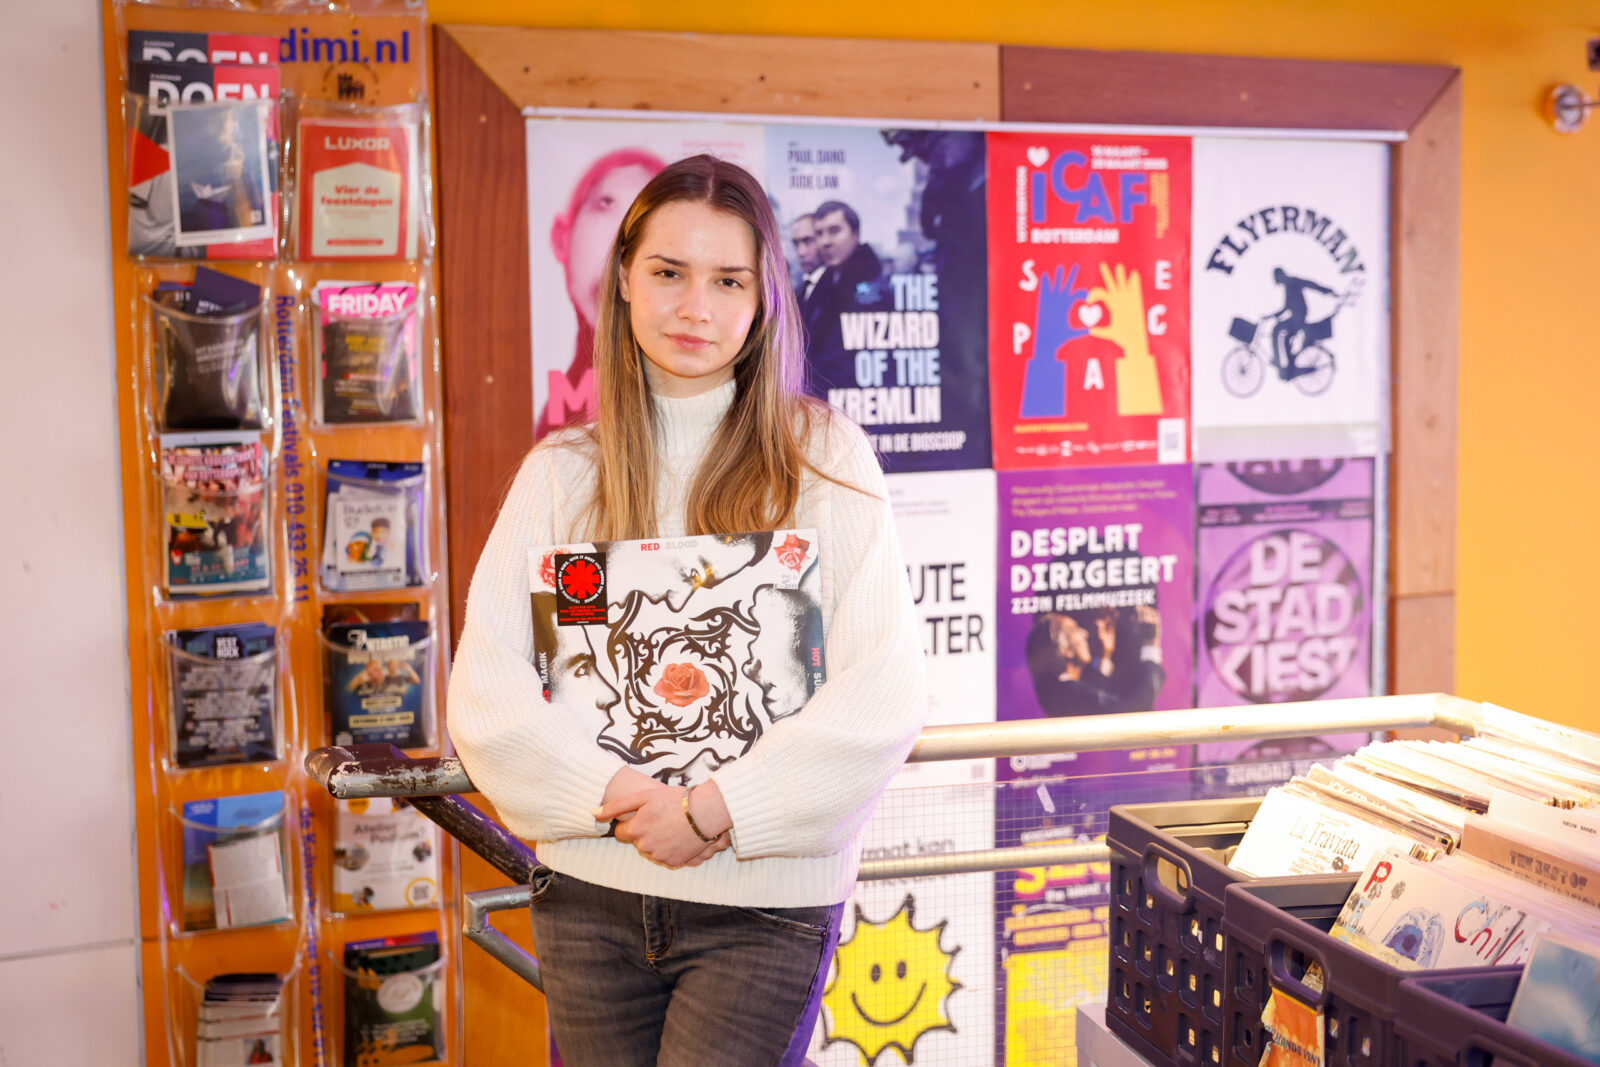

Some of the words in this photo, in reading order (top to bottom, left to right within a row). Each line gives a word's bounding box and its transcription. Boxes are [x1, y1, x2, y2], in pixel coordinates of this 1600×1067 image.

[325, 136, 390, 150] LUXOR
[321, 196, 394, 208] feestdagen
[334, 184, 360, 195] Vier
[364, 186, 380, 195] de
[1030, 228, 1120, 244] ROTTERDAM
[1206, 206, 1366, 275] FLYERMAN
[327, 292, 408, 315] FRIDAY
[890, 273, 940, 312] THE
[276, 295, 298, 393] Rotterdam
[839, 311, 940, 351] WIZARD
[854, 350, 888, 387] OF
[892, 348, 942, 387] THE
[828, 385, 942, 426] KREMLIN
[281, 398, 304, 478] Festivals
[910, 430, 967, 452] BIOSCOOP
[641, 543, 660, 551] RED
[665, 540, 698, 550] BLOOD
[1010, 523, 1143, 558] DESPLAT
[1250, 532, 1323, 586] DE
[1010, 554, 1179, 593] DIRIGEERT
[1011, 595, 1053, 615] ZIJN
[1056, 588, 1157, 612] FILMMUZIEK
[1212, 584, 1353, 645] STAD
[924, 614, 985, 656] TER
[539, 651, 549, 684] MAGIK
[812, 647, 821, 667] HOT
[1210, 636, 1359, 695] KIEST
[1308, 821, 1360, 860] Traviata
